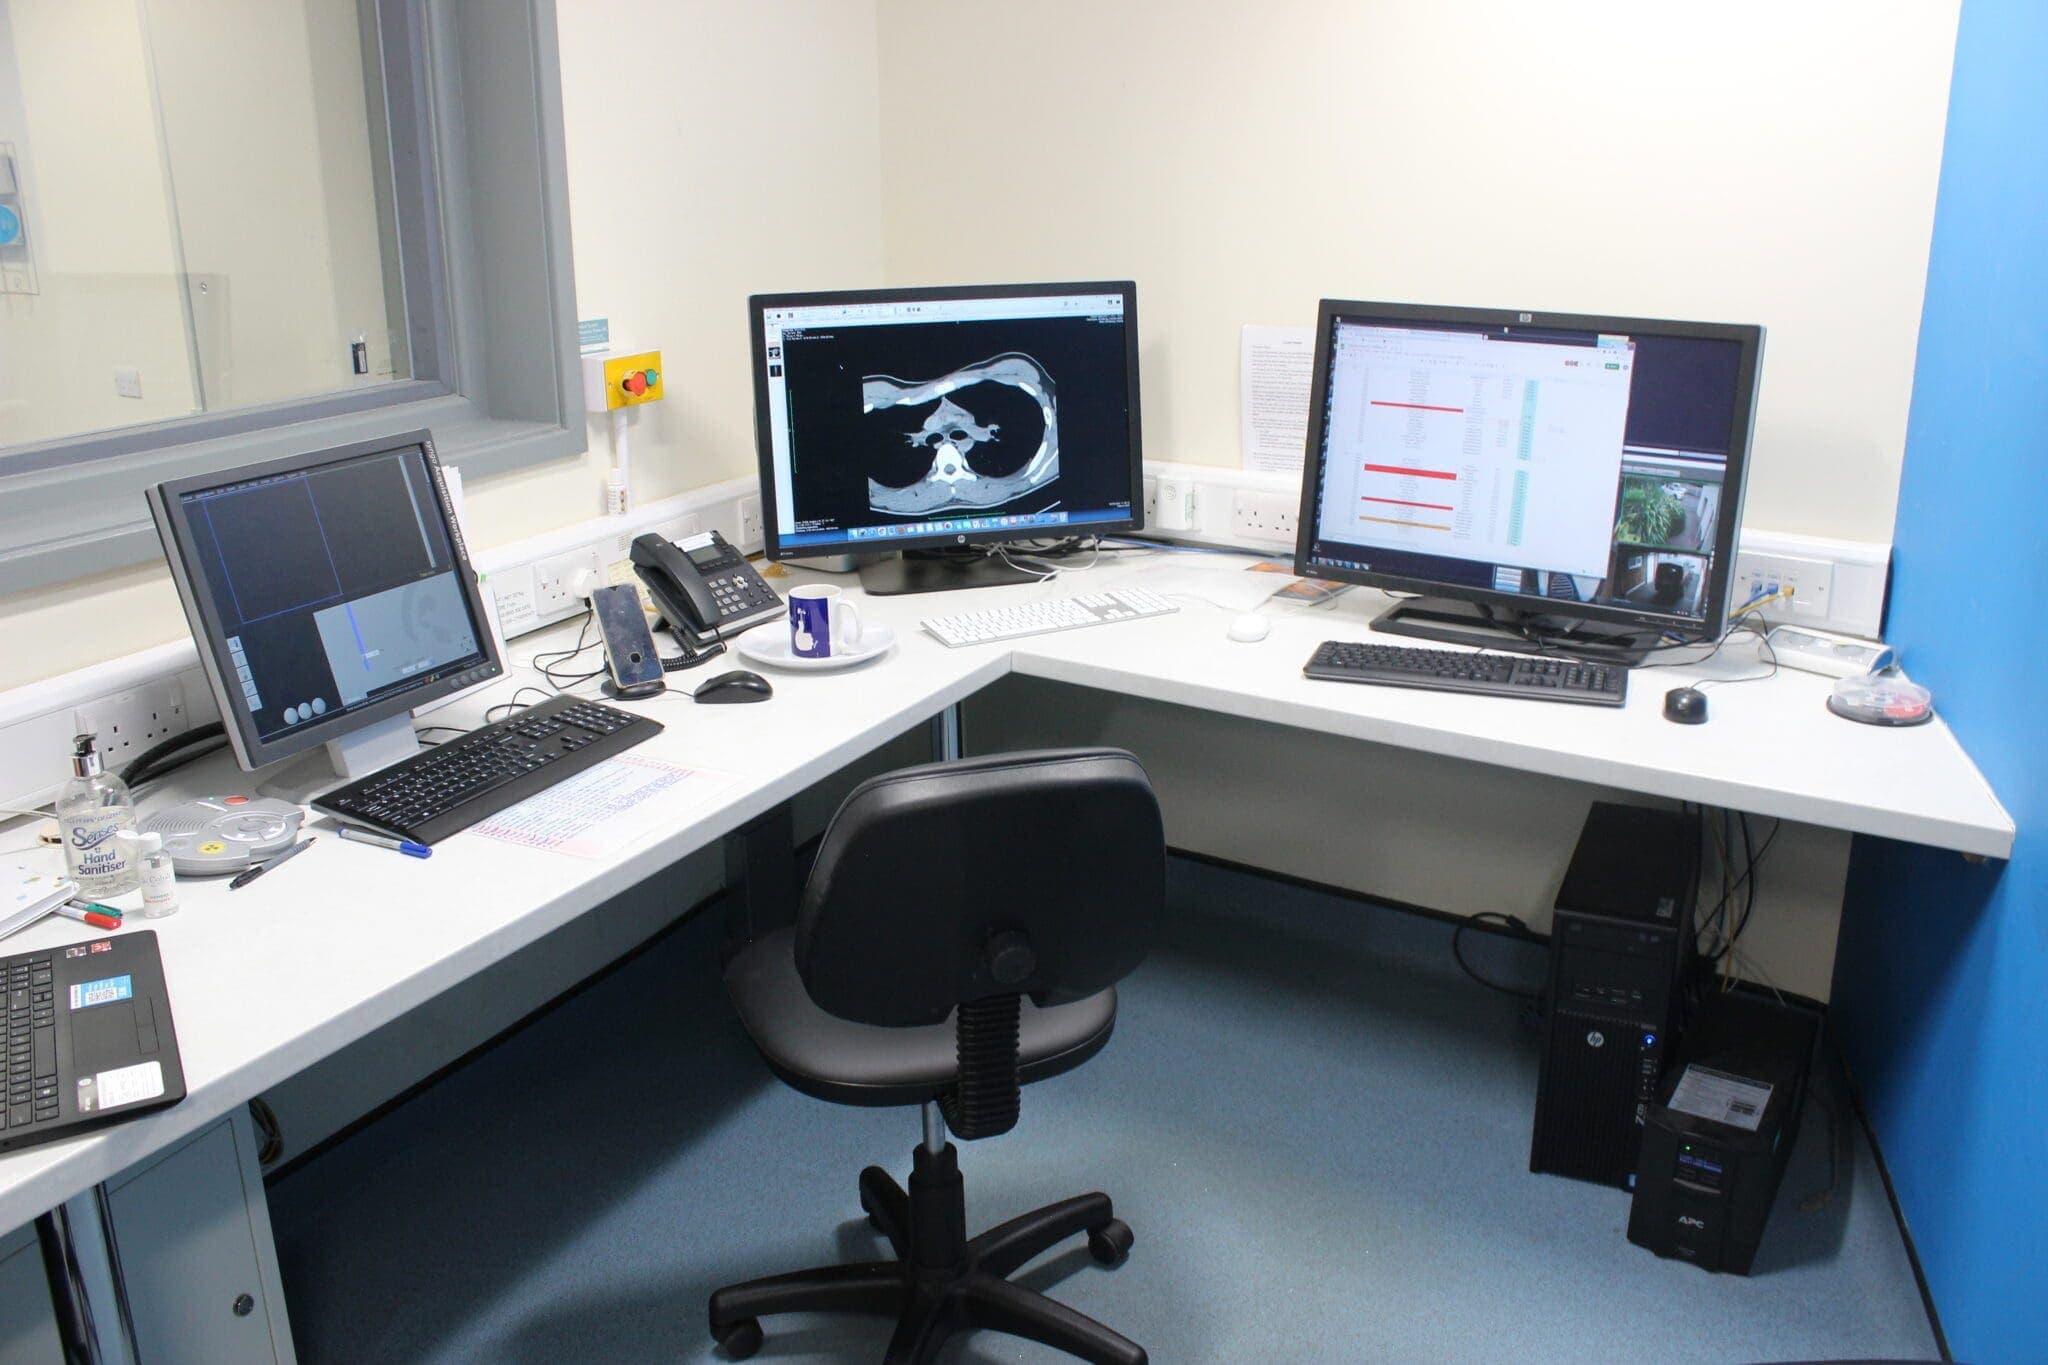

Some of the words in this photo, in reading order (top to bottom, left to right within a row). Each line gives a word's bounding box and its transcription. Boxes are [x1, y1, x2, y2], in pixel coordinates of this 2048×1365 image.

[434, 466, 453, 514] Acquisition
[450, 515, 467, 561] Workplace
[72, 823, 119, 848] Senses
[84, 849, 115, 865] Hand
[78, 860, 126, 876] Sanitiser
[1679, 1216, 1704, 1229] APC
